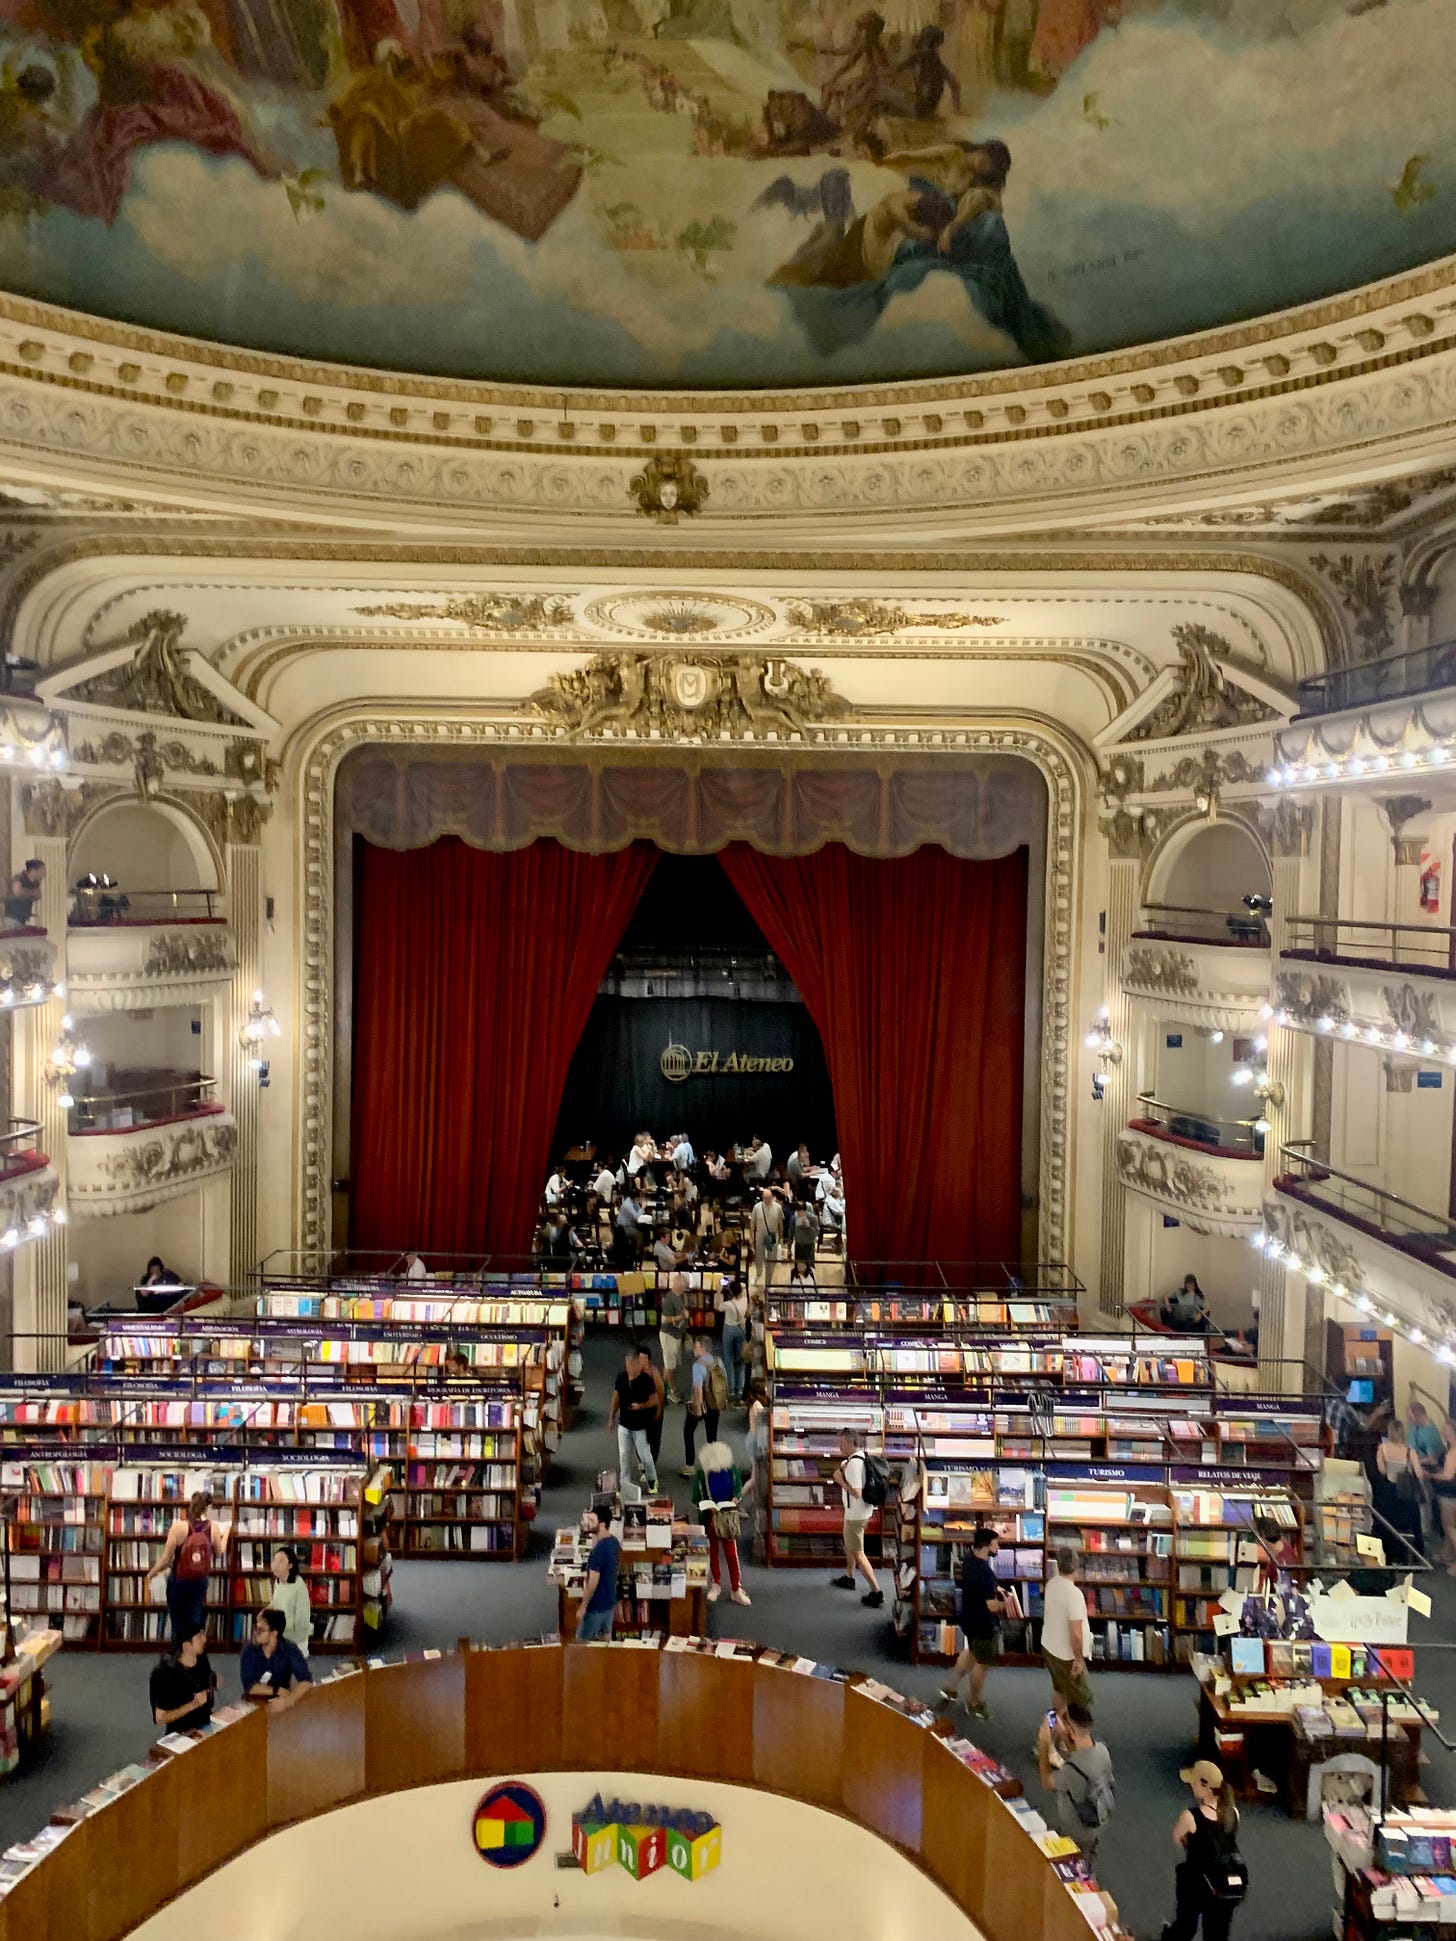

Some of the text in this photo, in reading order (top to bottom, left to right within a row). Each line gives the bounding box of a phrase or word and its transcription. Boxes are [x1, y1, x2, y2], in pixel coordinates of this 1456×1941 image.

[693, 1051, 794, 1072] El Ateneo
[816, 1391, 840, 1399] MANGA
[924, 1393, 948, 1401] MANGA
[1088, 1468, 1125, 1477] TURISMO
[1242, 1472, 1262, 1481] VIAJE
